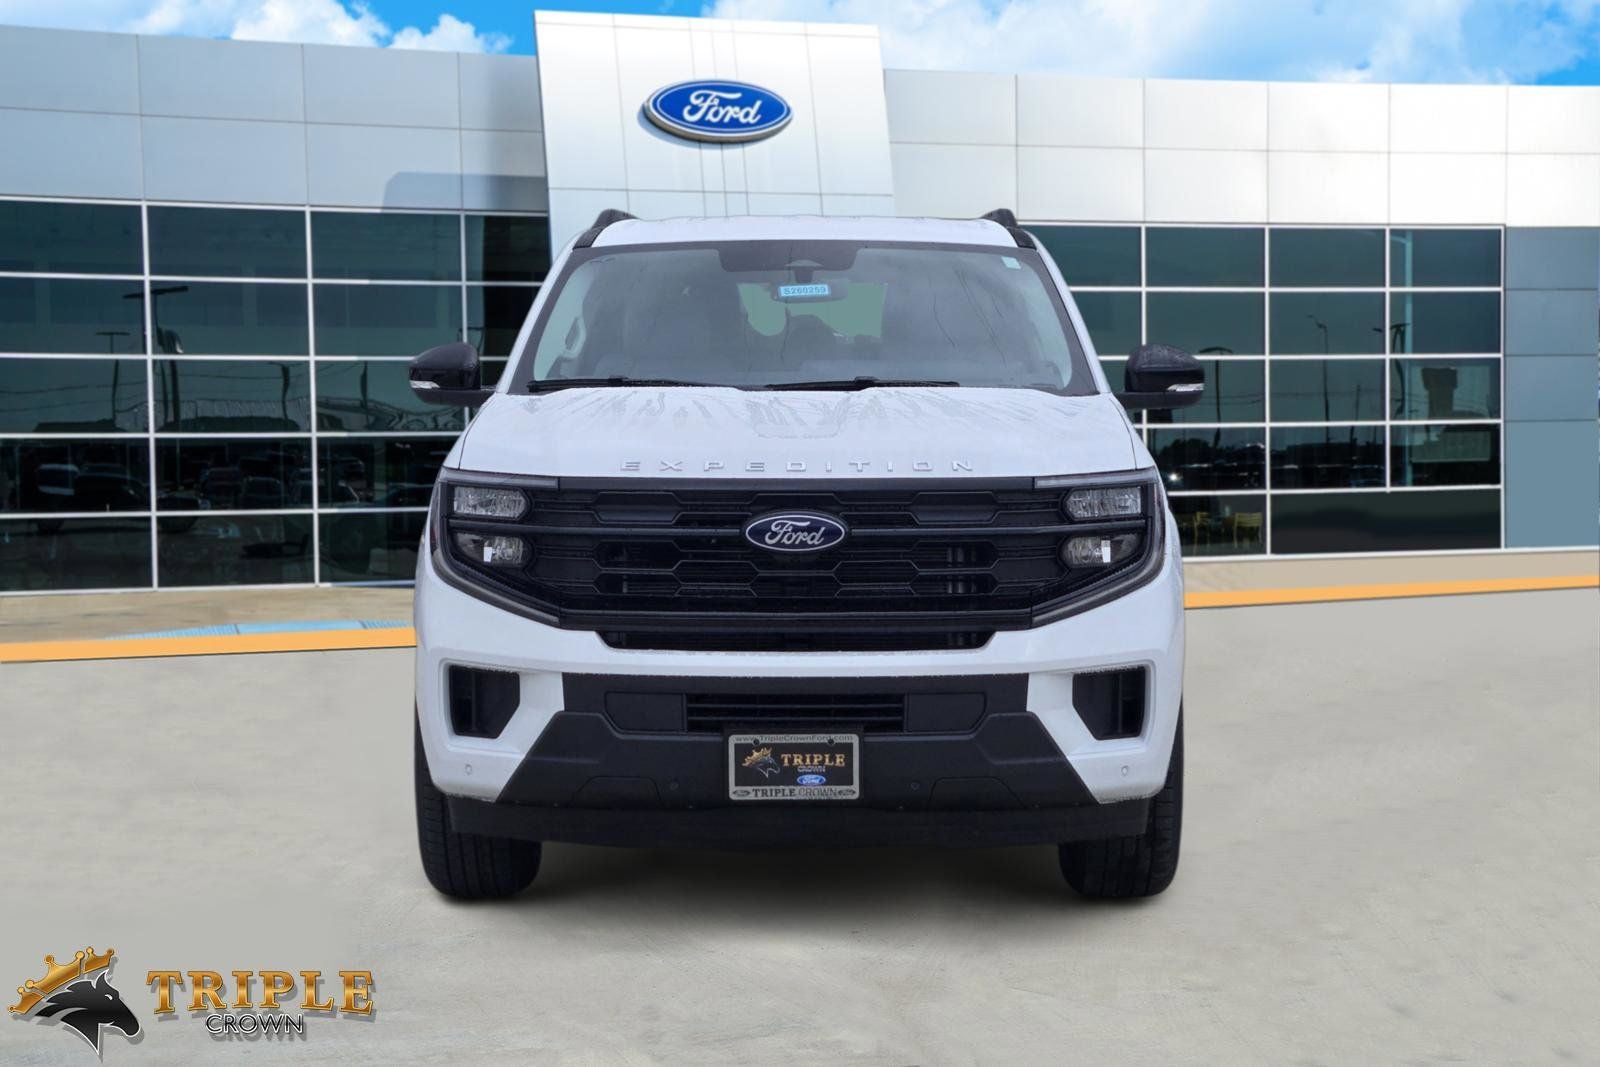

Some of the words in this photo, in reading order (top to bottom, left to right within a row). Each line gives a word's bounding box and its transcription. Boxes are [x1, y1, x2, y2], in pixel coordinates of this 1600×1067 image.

[682, 89, 763, 124] Ford
[620, 460, 974, 472] EXPEDITION
[764, 519, 825, 546] Ford
[780, 753, 846, 767] TRIPLE
[752, 788, 796, 798] TRIPLE
[798, 788, 837, 797] CROWN
